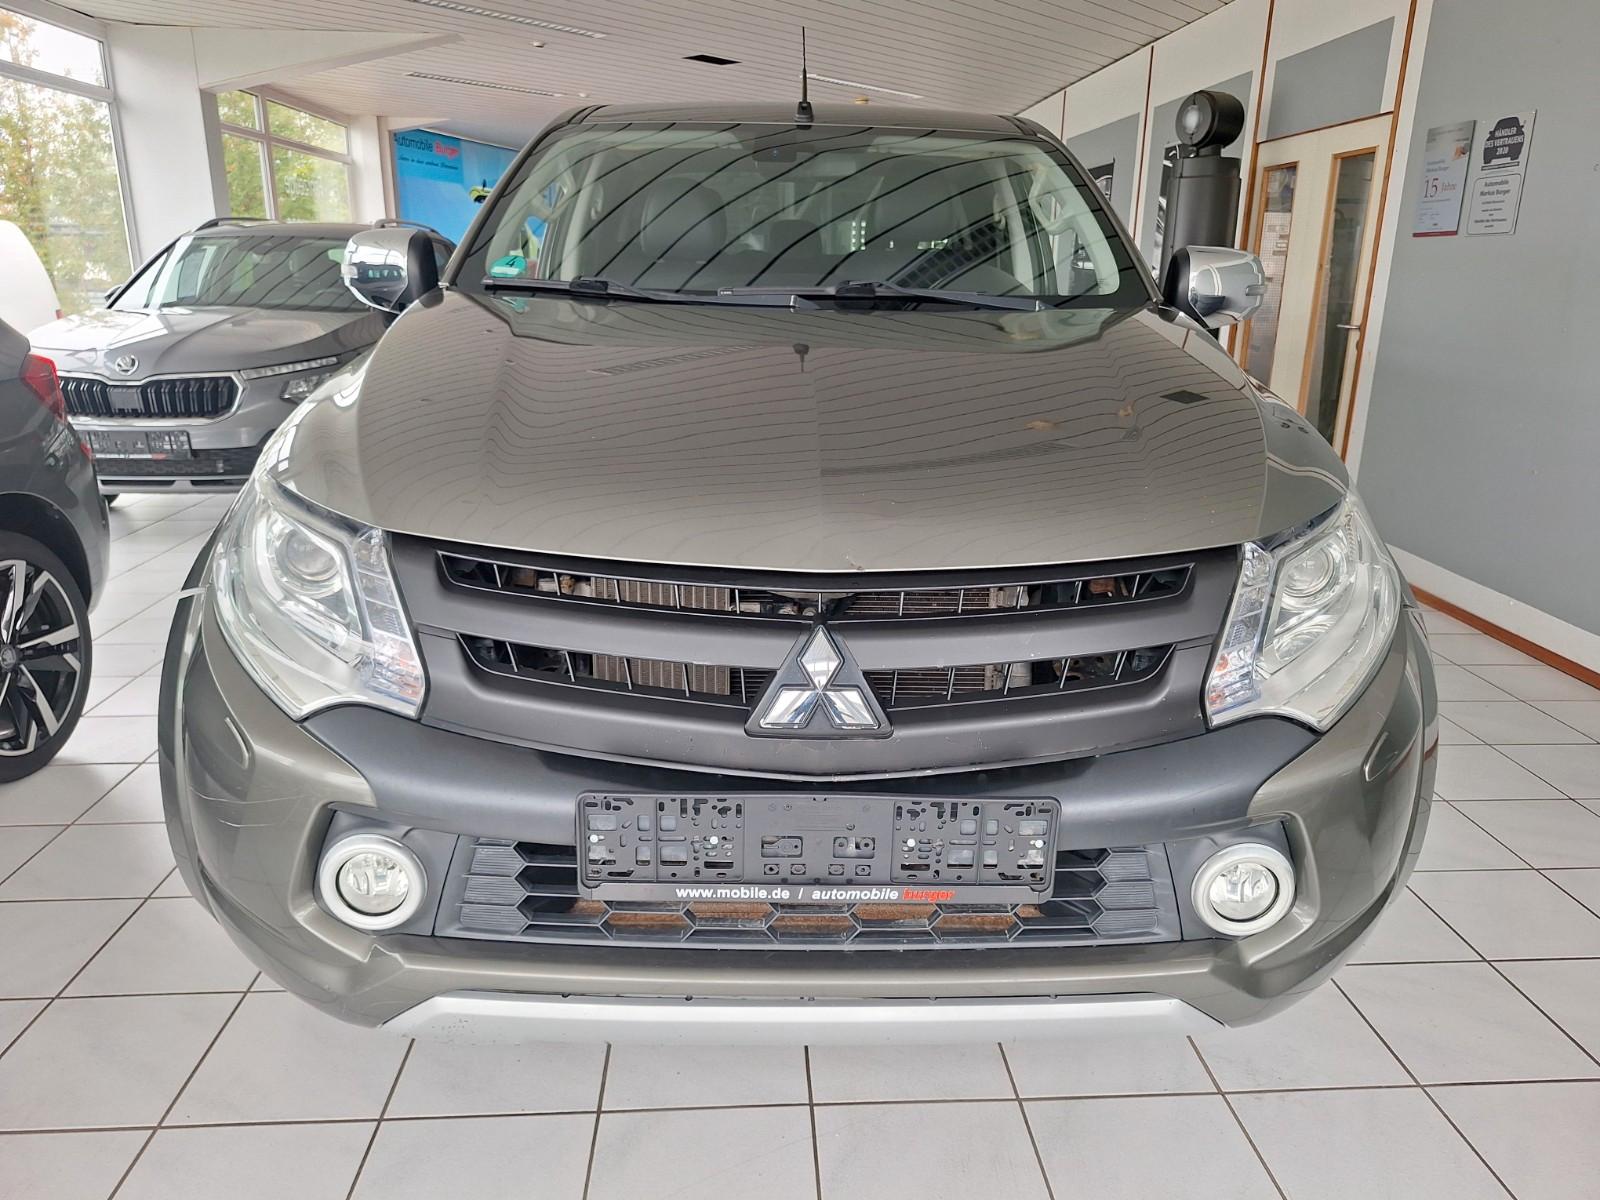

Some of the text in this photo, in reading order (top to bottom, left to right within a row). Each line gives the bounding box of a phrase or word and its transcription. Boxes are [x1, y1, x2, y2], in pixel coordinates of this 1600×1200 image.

[1424, 177, 1439, 199] 15
[675, 886, 956, 903] www.mobile.de / automobile burger
